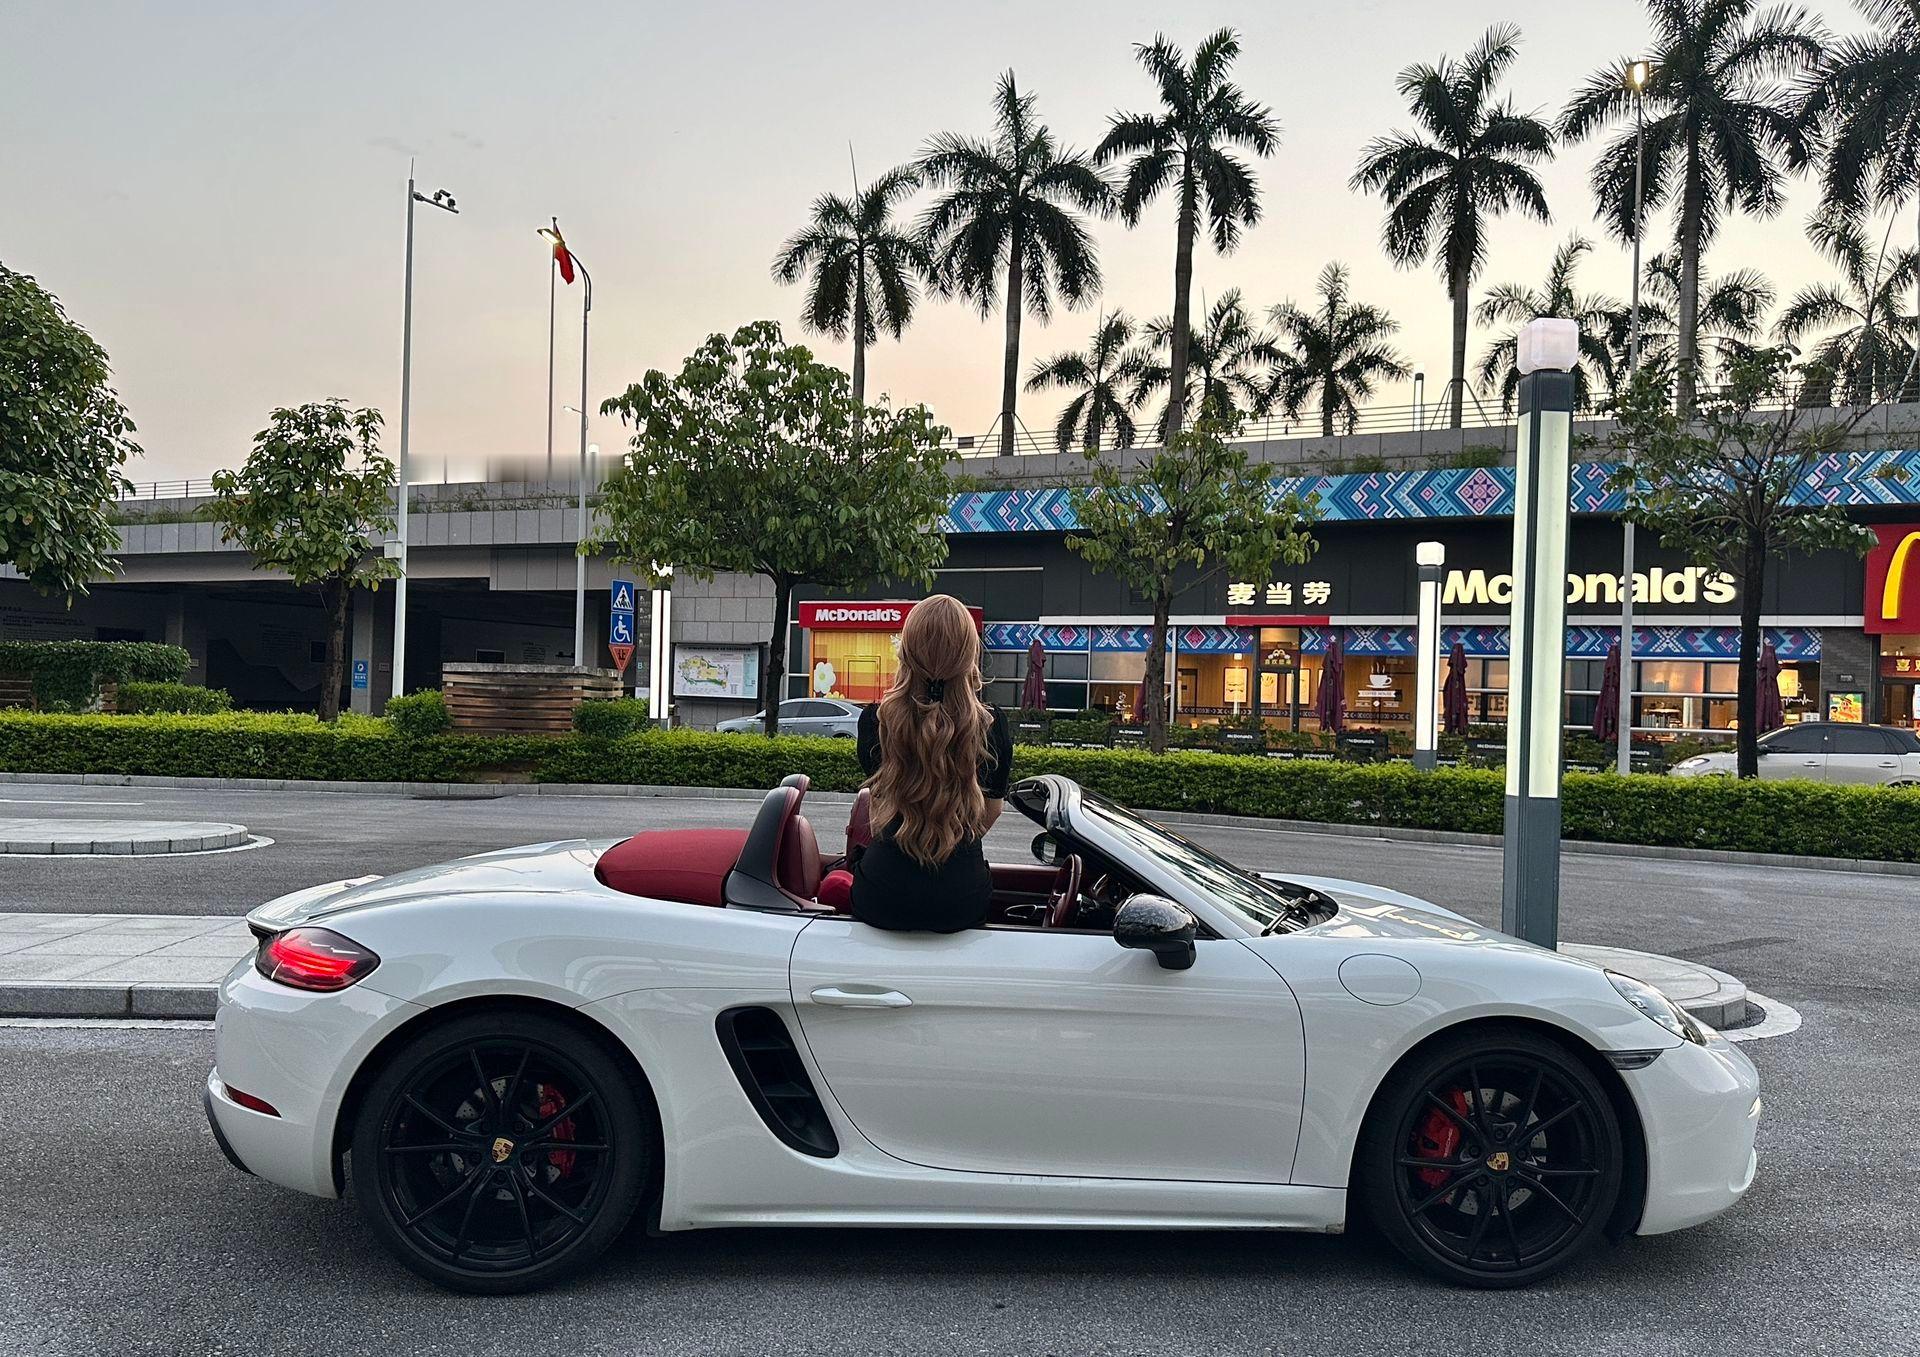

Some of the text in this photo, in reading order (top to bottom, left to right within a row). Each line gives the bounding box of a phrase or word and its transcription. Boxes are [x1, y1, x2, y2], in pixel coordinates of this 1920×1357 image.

[1227, 581, 1331, 605] 麦当劳
[1442, 566, 1736, 604] Mconald's
[815, 608, 901, 622] McDonald's
